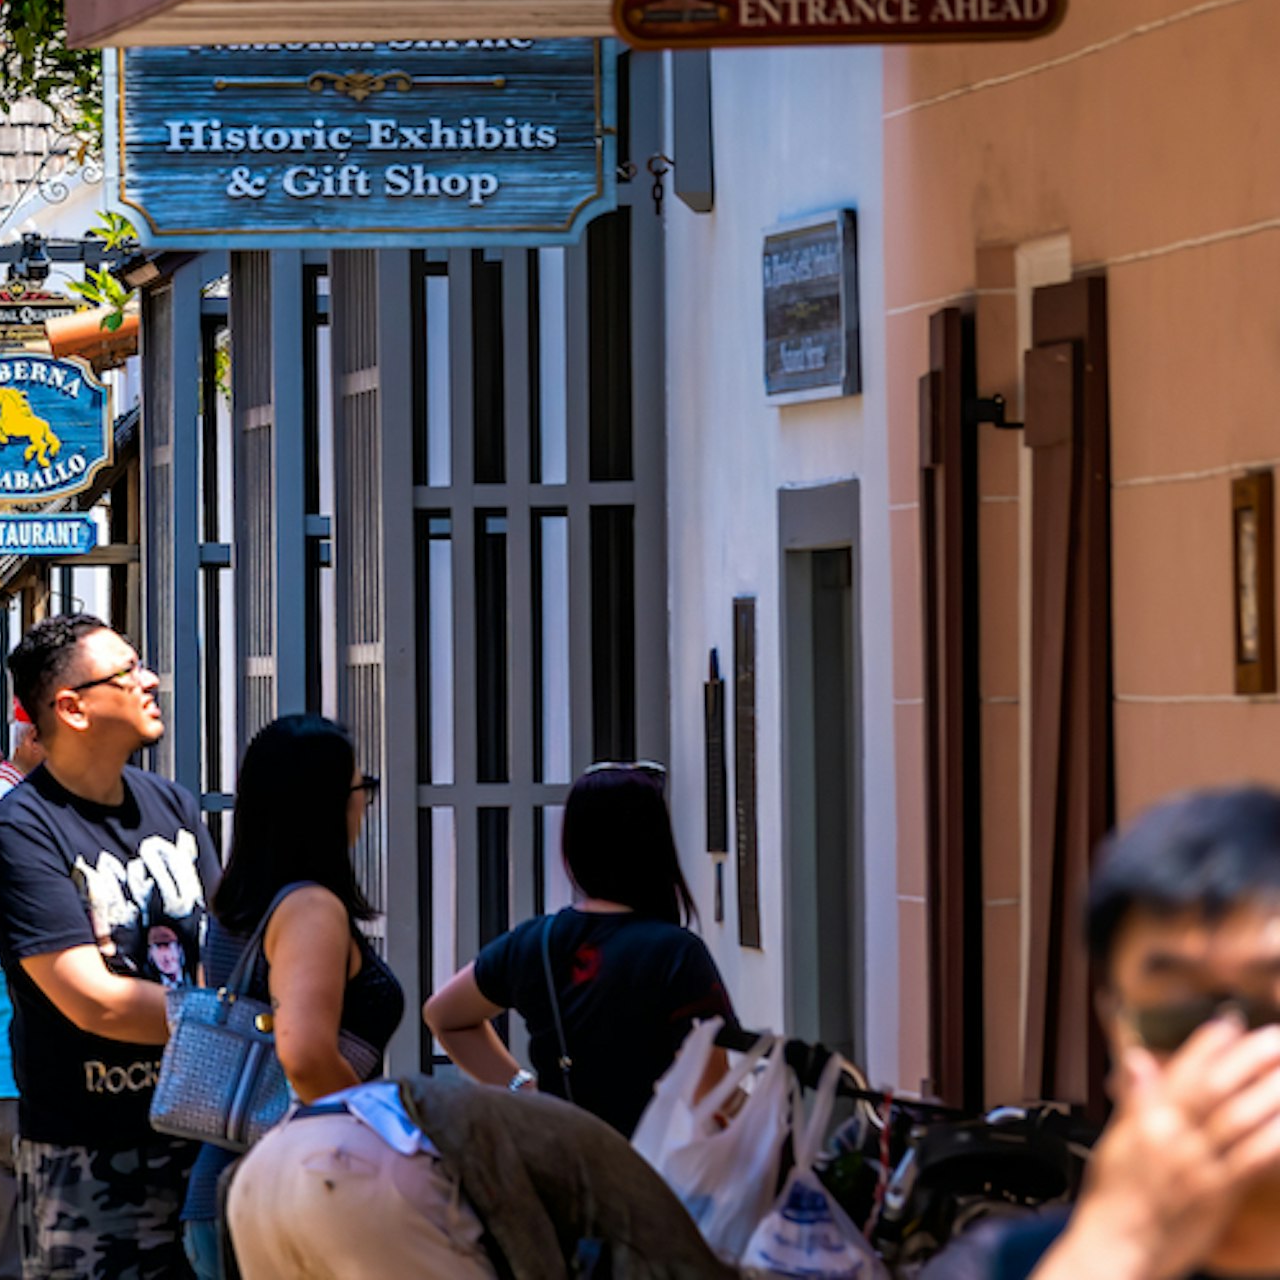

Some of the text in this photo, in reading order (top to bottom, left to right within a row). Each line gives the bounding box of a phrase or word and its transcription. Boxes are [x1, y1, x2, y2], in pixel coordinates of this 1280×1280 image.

[164, 118, 558, 153] Historic Exhibits
[225, 165, 499, 206] & Gift Shop
